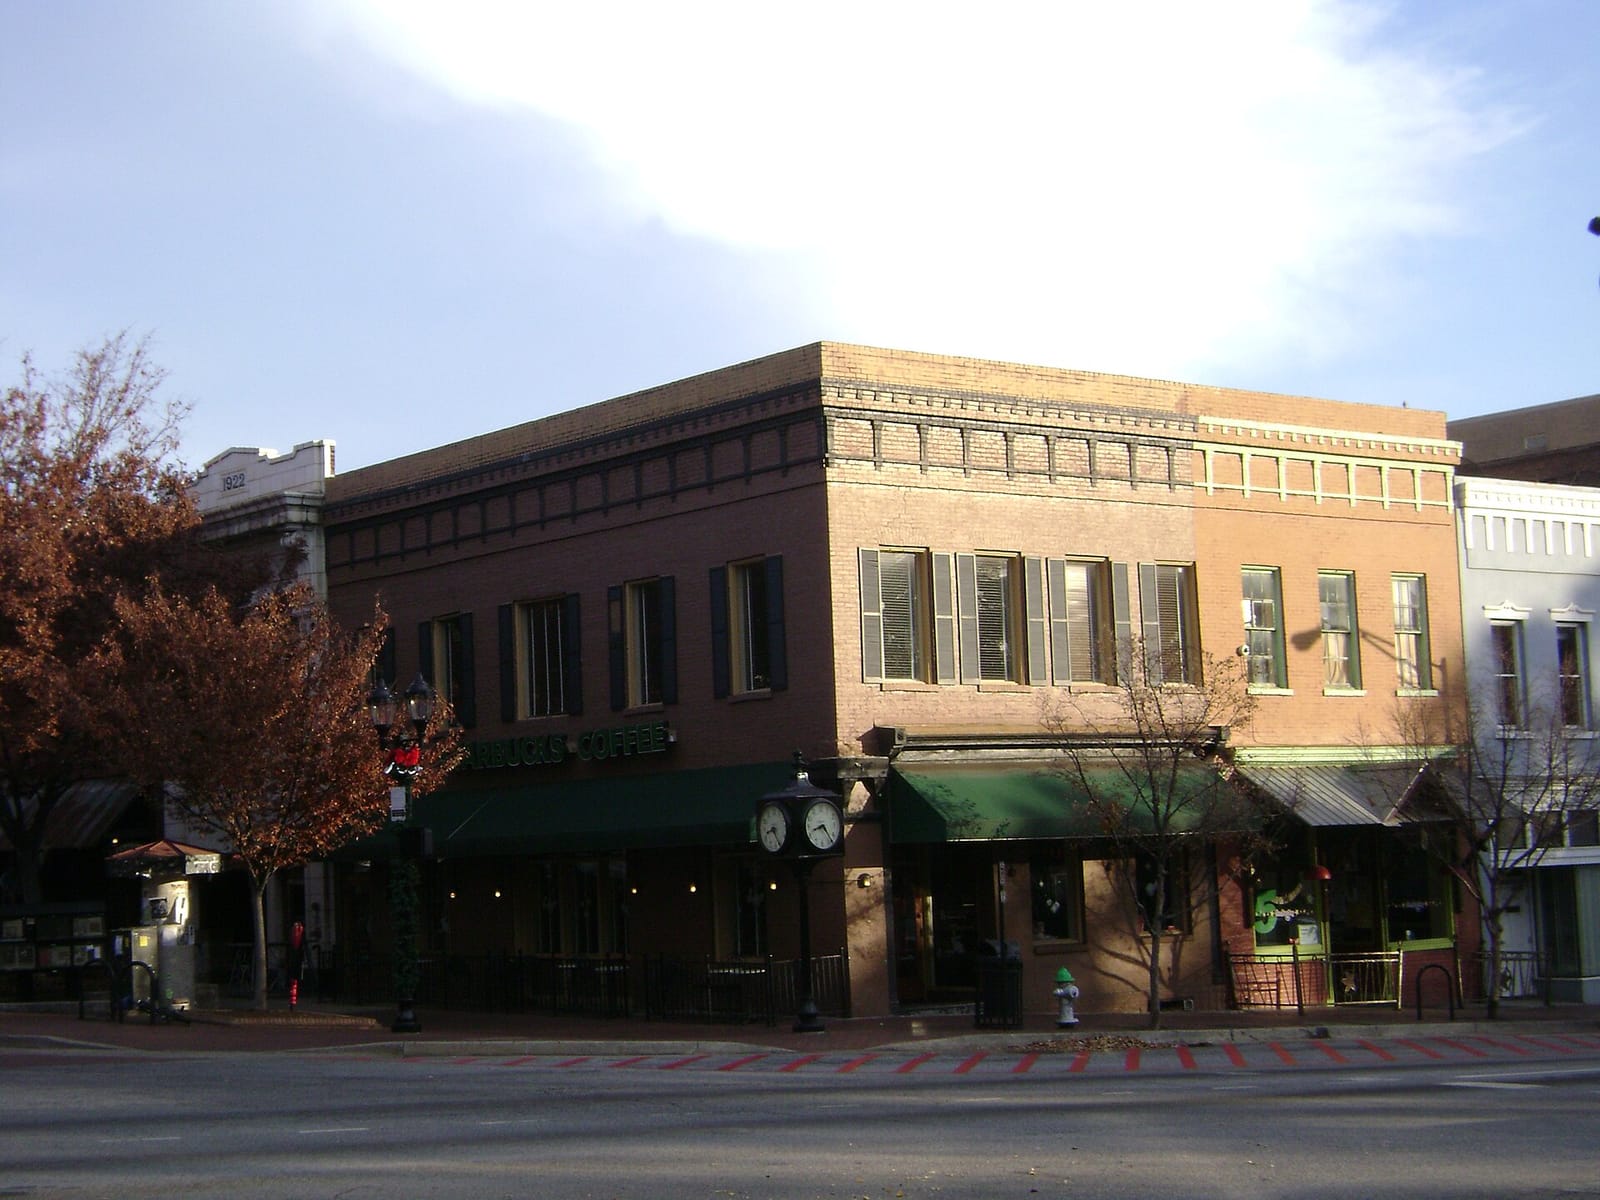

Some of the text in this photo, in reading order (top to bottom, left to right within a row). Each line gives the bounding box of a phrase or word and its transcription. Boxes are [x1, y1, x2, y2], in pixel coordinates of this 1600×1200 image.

[223, 473, 245, 491] 1922
[461, 721, 666, 769] ARBUCKS COFFEE
